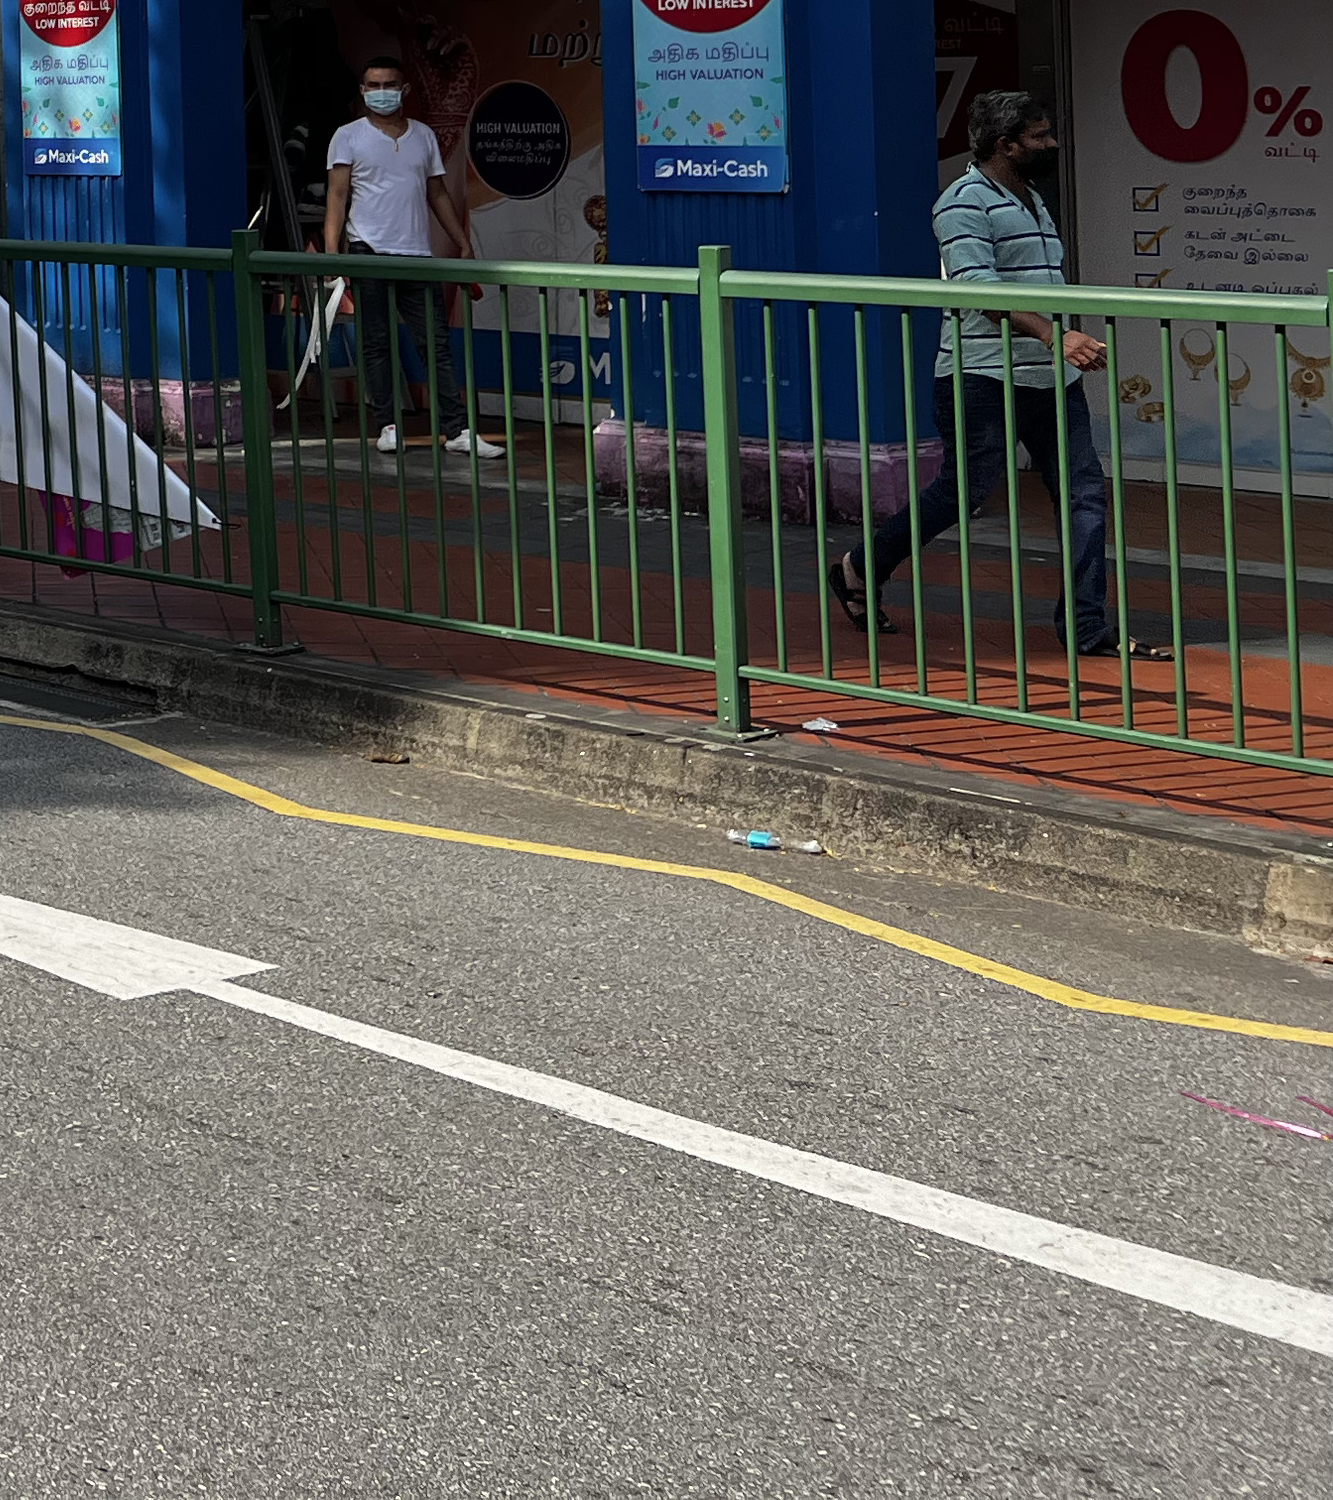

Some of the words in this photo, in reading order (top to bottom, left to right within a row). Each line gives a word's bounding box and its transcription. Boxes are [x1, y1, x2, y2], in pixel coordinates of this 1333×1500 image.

[35, 18, 56, 29] LOW
[58, 16, 99, 29] INTEREST
[648, 43, 699, 63] அதிக
[34, 76, 55, 86] HIGH
[57, 75, 105, 85] VALUATION
[655, 69, 687, 81] HIGH
[691, 68, 764, 80] VALUATION
[477, 122, 502, 134] HIGH
[504, 122, 560, 134] VALUATION
[48, 150, 109, 165] Maxi-Cash
[1264, 142, 1321, 163] வட்டி
[676, 159, 768, 179] Maxi-Cash
